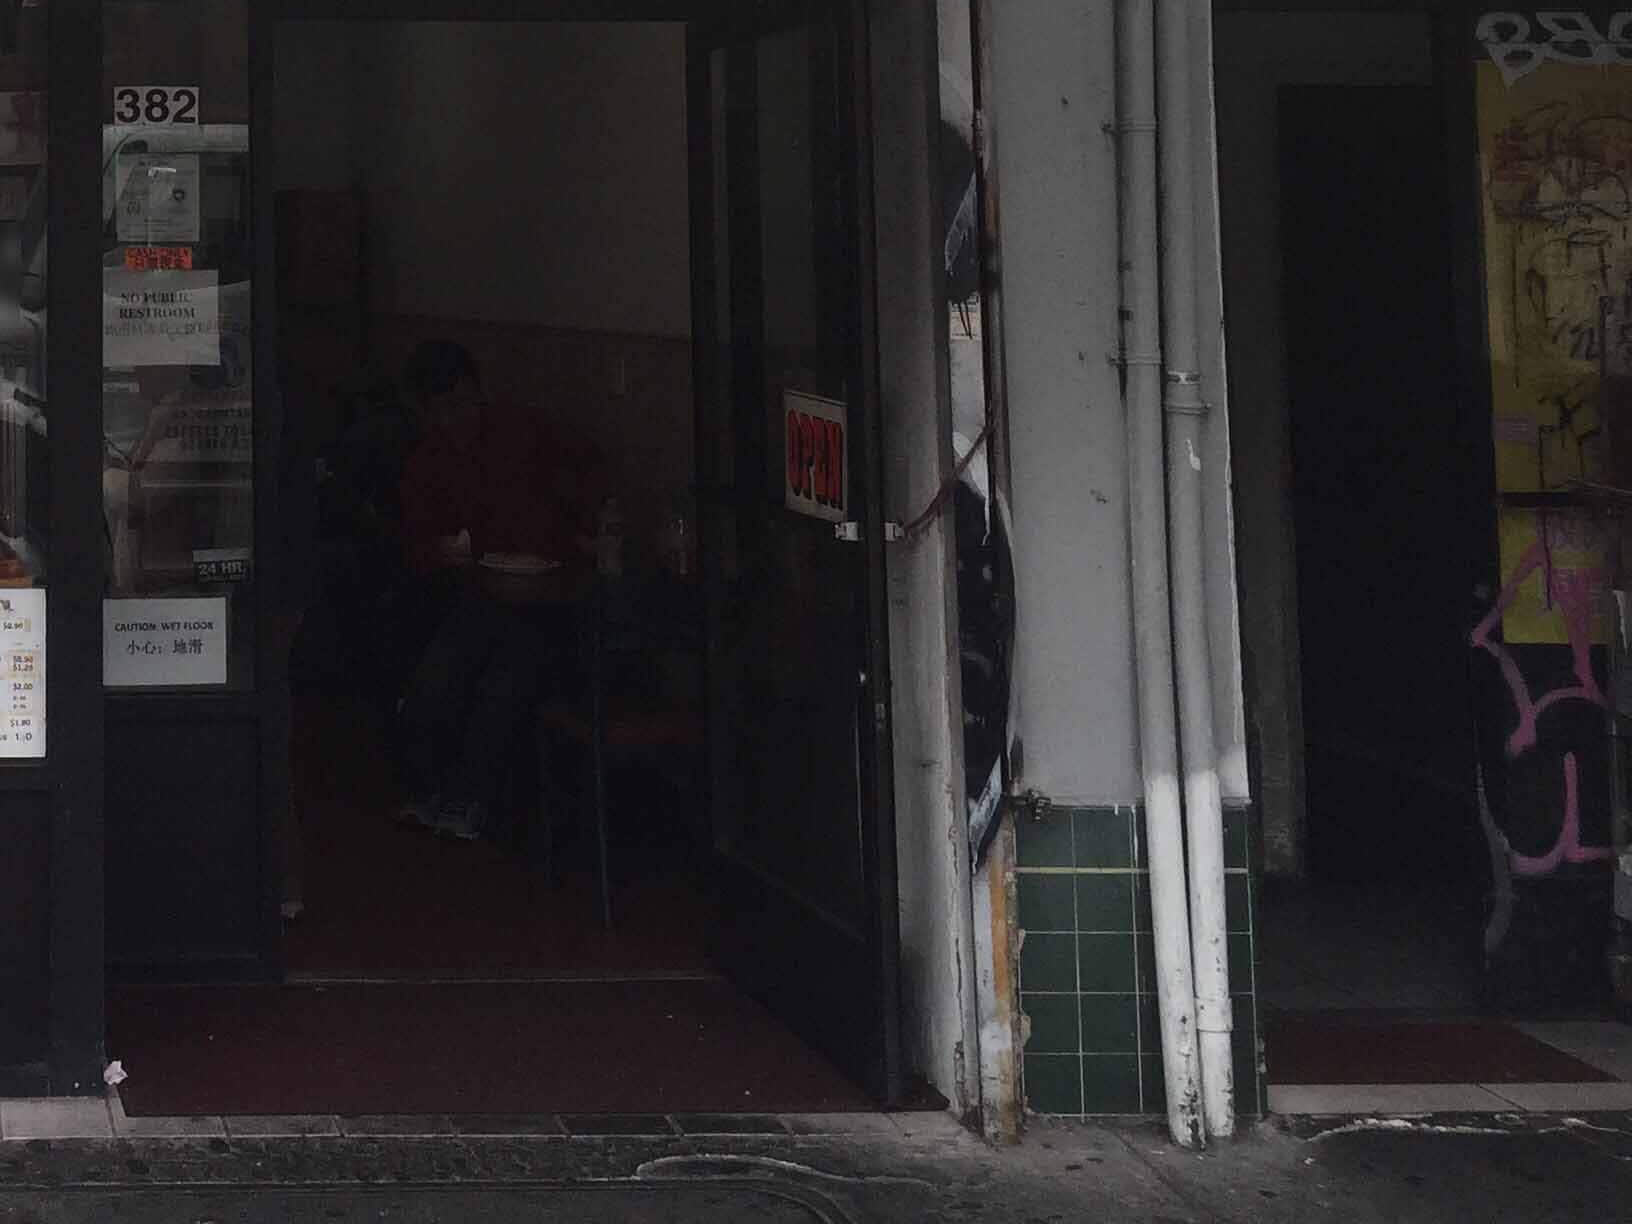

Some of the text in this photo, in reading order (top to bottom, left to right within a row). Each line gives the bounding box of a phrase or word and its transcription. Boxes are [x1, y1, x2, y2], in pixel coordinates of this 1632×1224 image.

[116, 88, 197, 124] 382
[121, 292, 191, 304] NO PUBLIC
[119, 308, 195, 319] RESTROOM
[161, 622, 182, 630] WET
[184, 622, 213, 630] FLOOR
